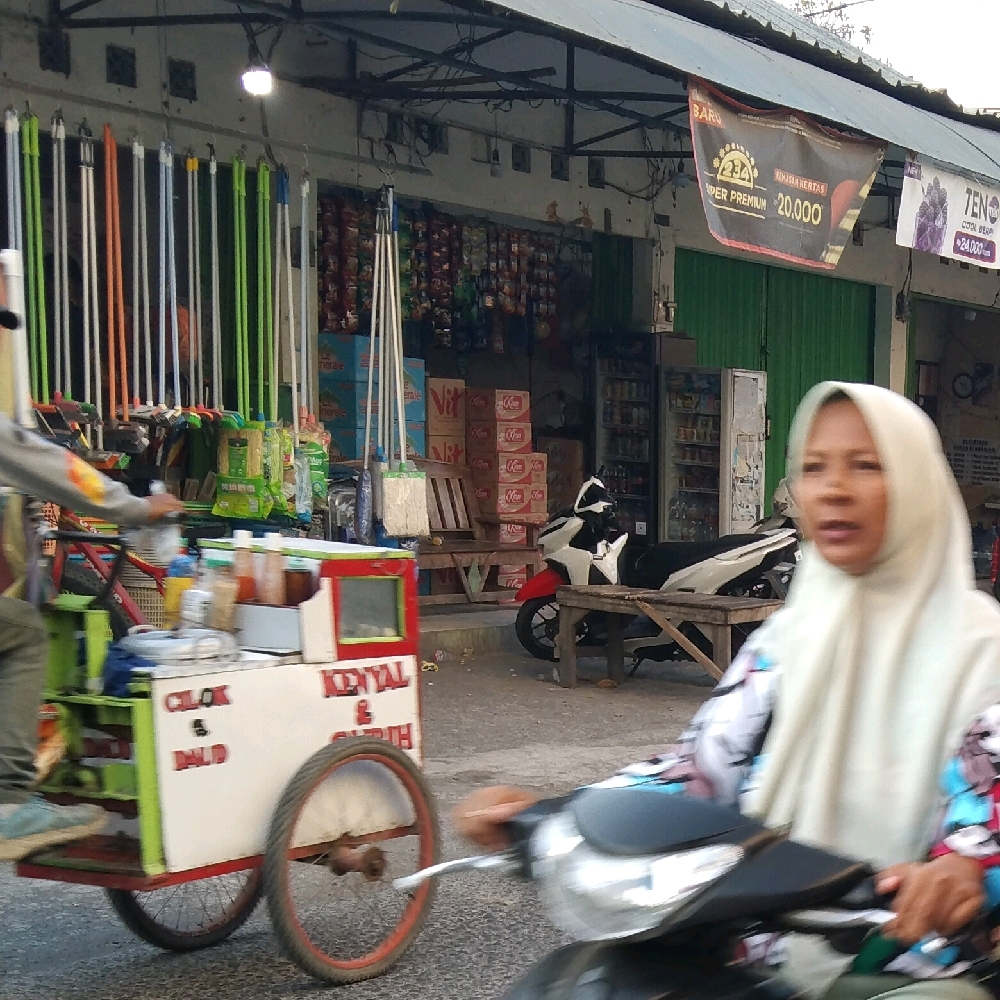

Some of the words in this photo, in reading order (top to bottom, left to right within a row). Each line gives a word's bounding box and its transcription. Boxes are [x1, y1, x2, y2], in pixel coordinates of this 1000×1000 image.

[693, 103, 722, 124] BARU
[721, 160, 750, 181] 234
[730, 190, 767, 211] PREMIUM
[430, 385, 463, 417] Vit
